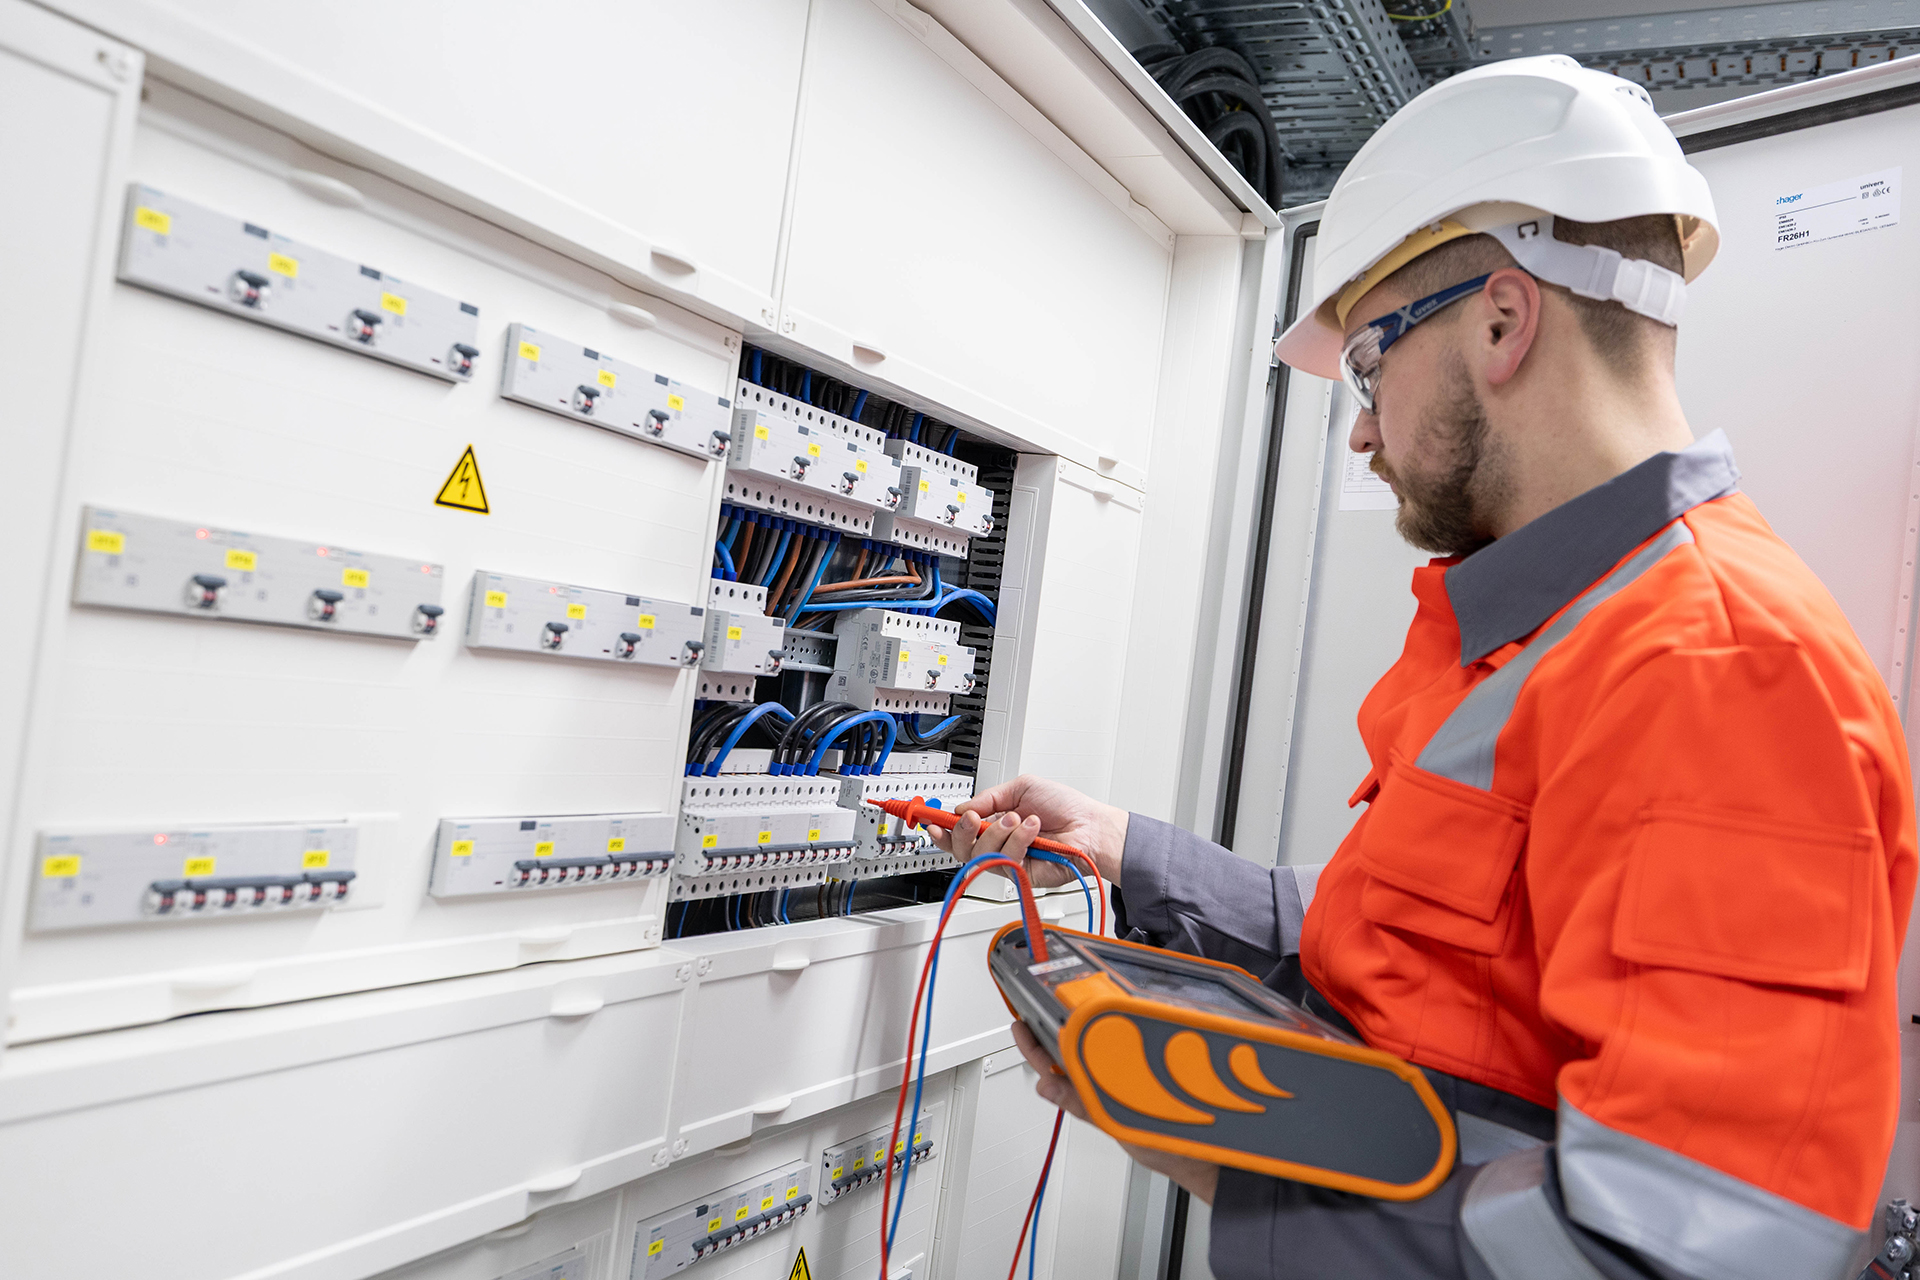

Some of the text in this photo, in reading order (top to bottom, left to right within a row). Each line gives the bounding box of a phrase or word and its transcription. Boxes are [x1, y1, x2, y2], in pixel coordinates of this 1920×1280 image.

[1860, 180, 1884, 190] univers
[1777, 230, 1810, 243] FR26H1
[1414, 298, 1438, 317] uvex
